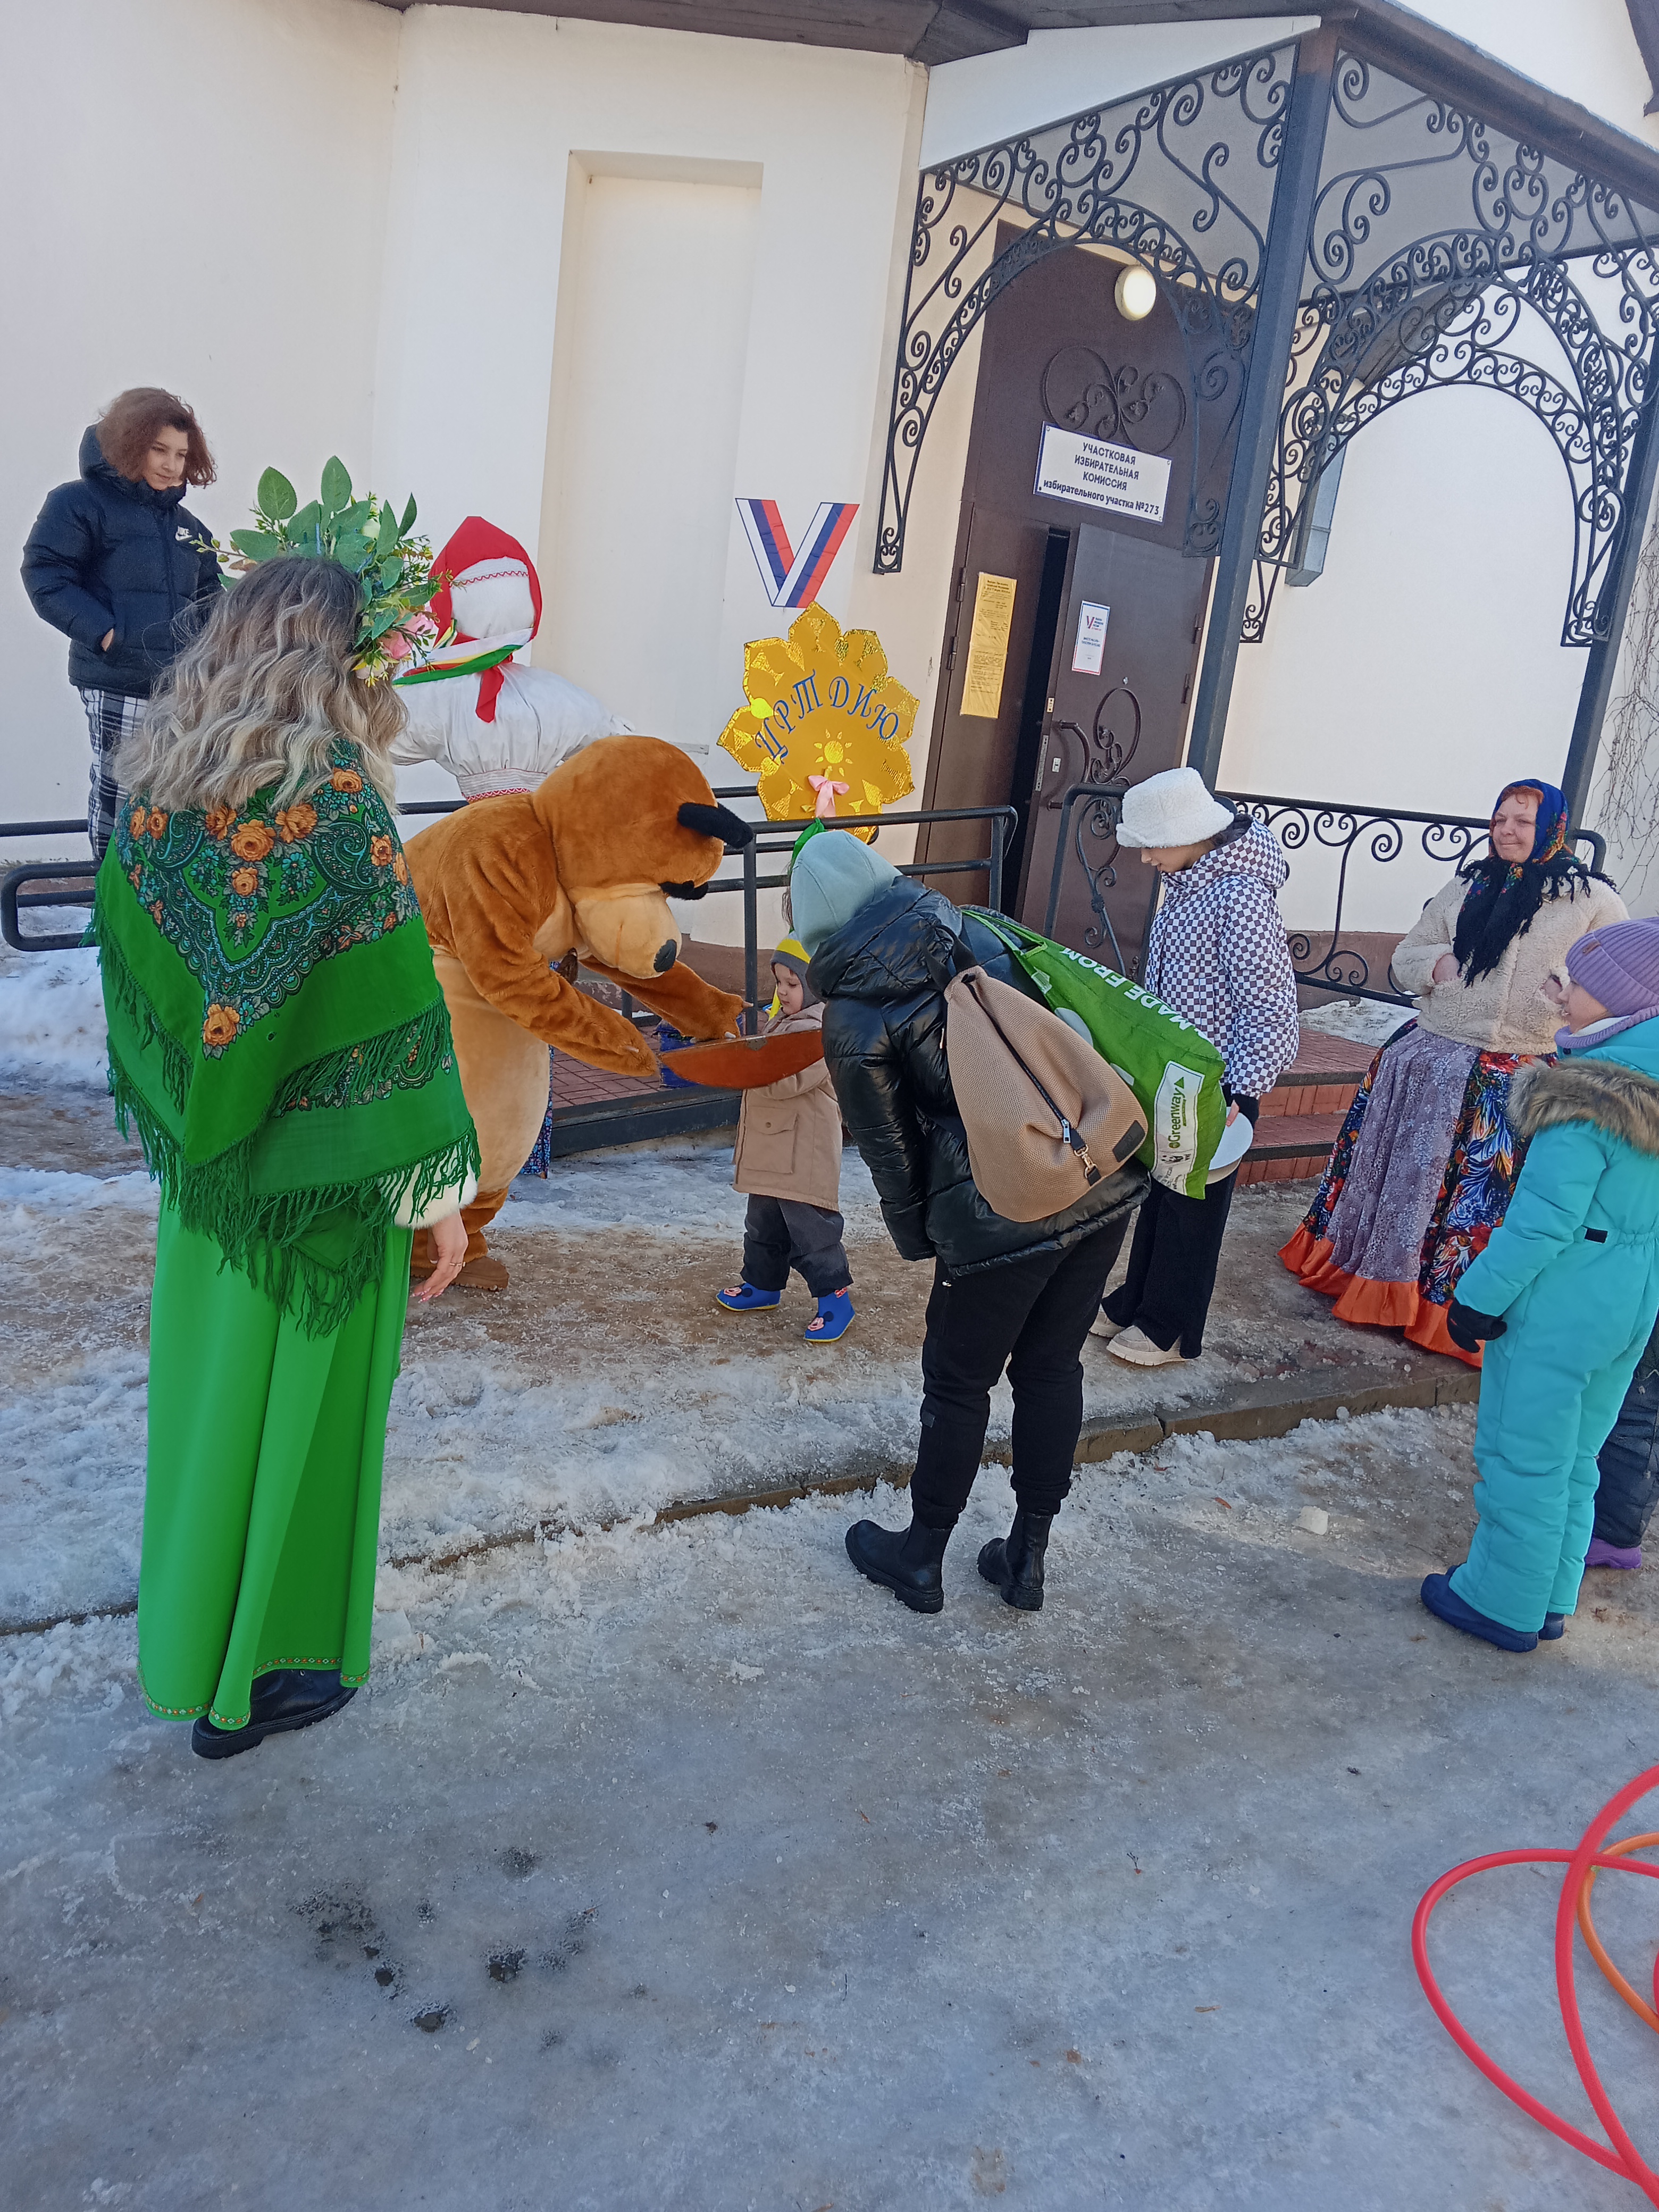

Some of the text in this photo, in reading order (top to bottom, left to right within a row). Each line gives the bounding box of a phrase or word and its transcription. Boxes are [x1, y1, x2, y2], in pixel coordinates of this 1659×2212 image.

[1074, 454, 1139, 480] ИЗБИРАТЕЛЬНАЯ
[1083, 442, 1136, 465] УЧАСТКОВАЯ
[1083, 471, 1127, 491] КОМИССИЯ
[1043, 480, 1159, 515] избирательного участка №273
[1059, 948, 1192, 1030] MADE FROM
[1168, 1087, 1185, 1142] Greenway
